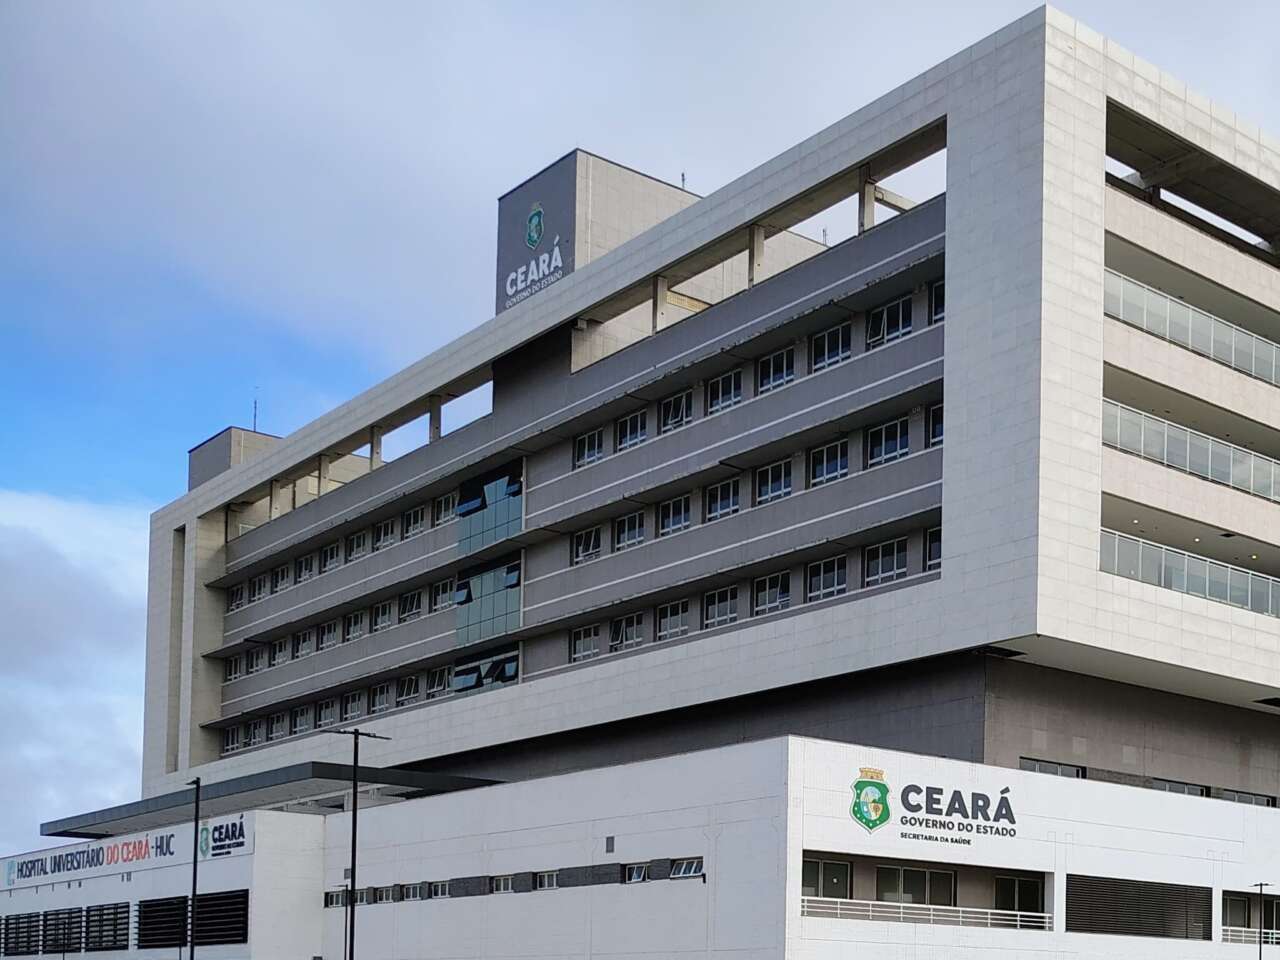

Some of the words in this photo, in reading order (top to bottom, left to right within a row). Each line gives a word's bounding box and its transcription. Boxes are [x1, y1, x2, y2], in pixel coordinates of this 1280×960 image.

[505, 233, 563, 297] CEARÁ
[900, 784, 1016, 825] CEARÁ
[212, 813, 245, 844] CEARÁ
[900, 815, 955, 831] GOVERNO
[957, 822, 974, 833] DO
[976, 824, 1017, 838] ESTADO
[900, 831, 939, 843] SECRETARIA
[950, 836, 972, 846] SAÚDE
[17, 857, 49, 880] HOSPITAL
[50, 844, 105, 875] UNIVERSITÁRIO
[106, 844, 120, 866] DO
[121, 834, 151, 863] CEARÁ
[155, 833, 175, 858] HUC
